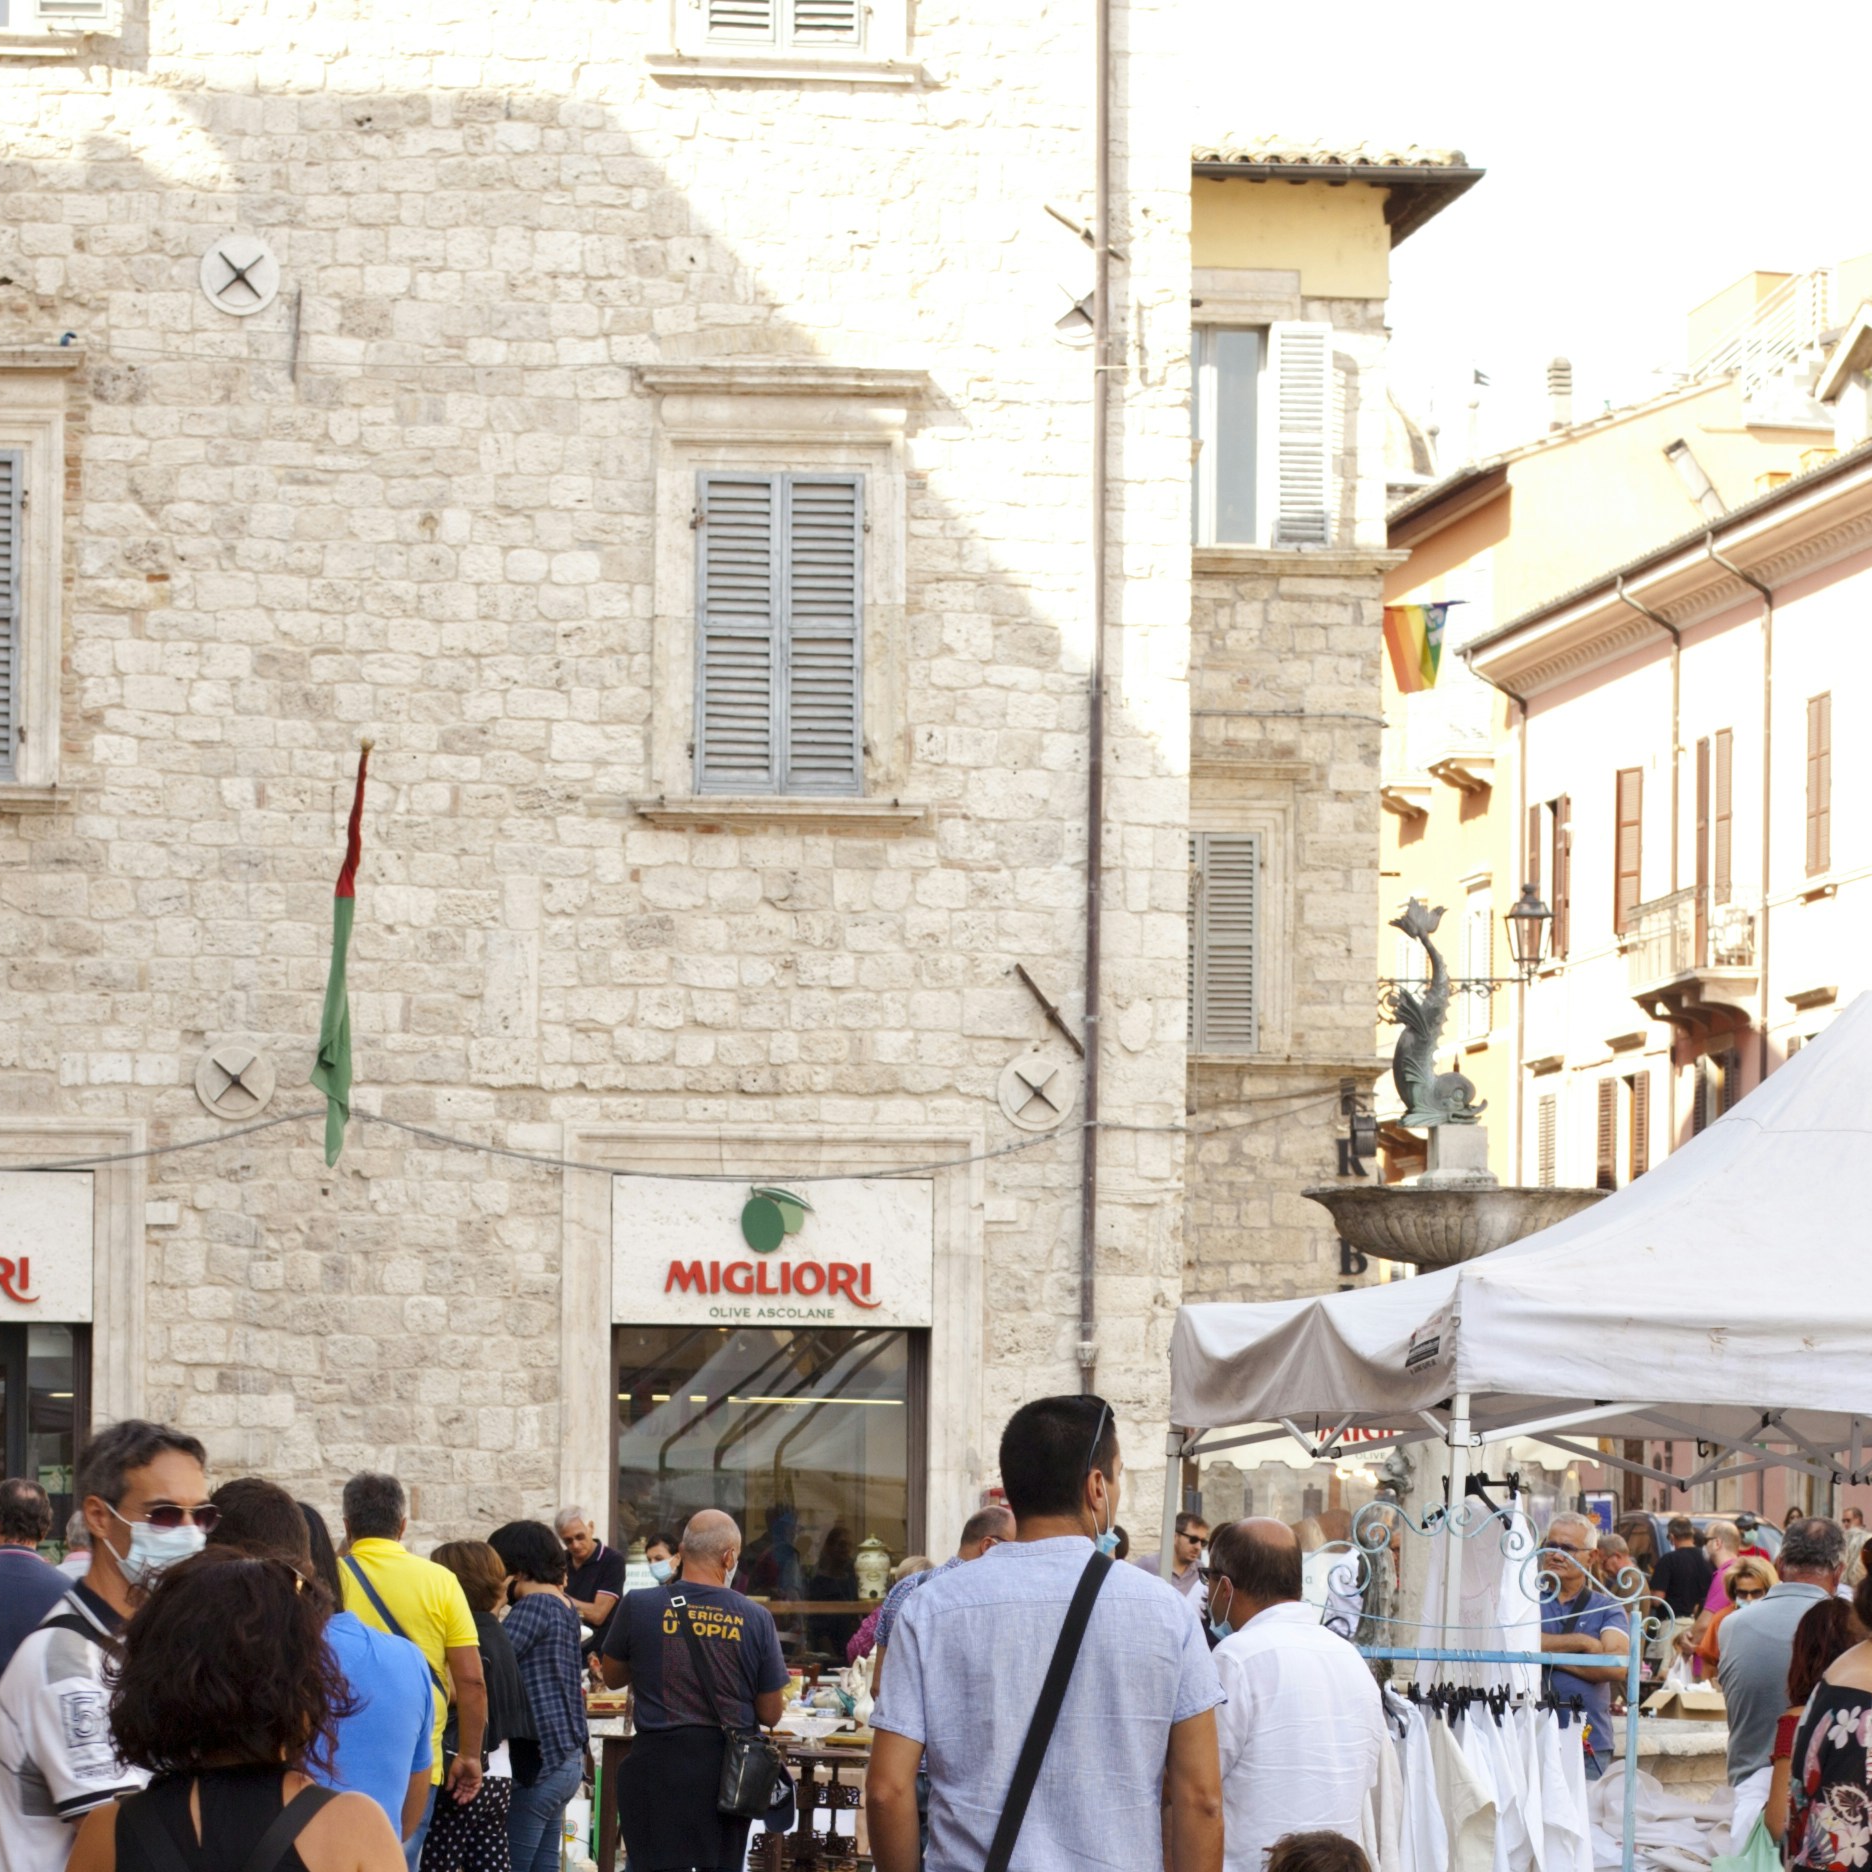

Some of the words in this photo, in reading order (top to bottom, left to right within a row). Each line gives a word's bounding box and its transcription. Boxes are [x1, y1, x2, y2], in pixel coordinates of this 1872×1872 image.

[664, 1259, 883, 1309] MIGLIORI
[709, 1307, 750, 1318] OLIVE
[756, 1308, 835, 1318] ASCOLANE
[663, 1609, 743, 1626] AERICAN
[663, 1620, 741, 1641] UOPIA
